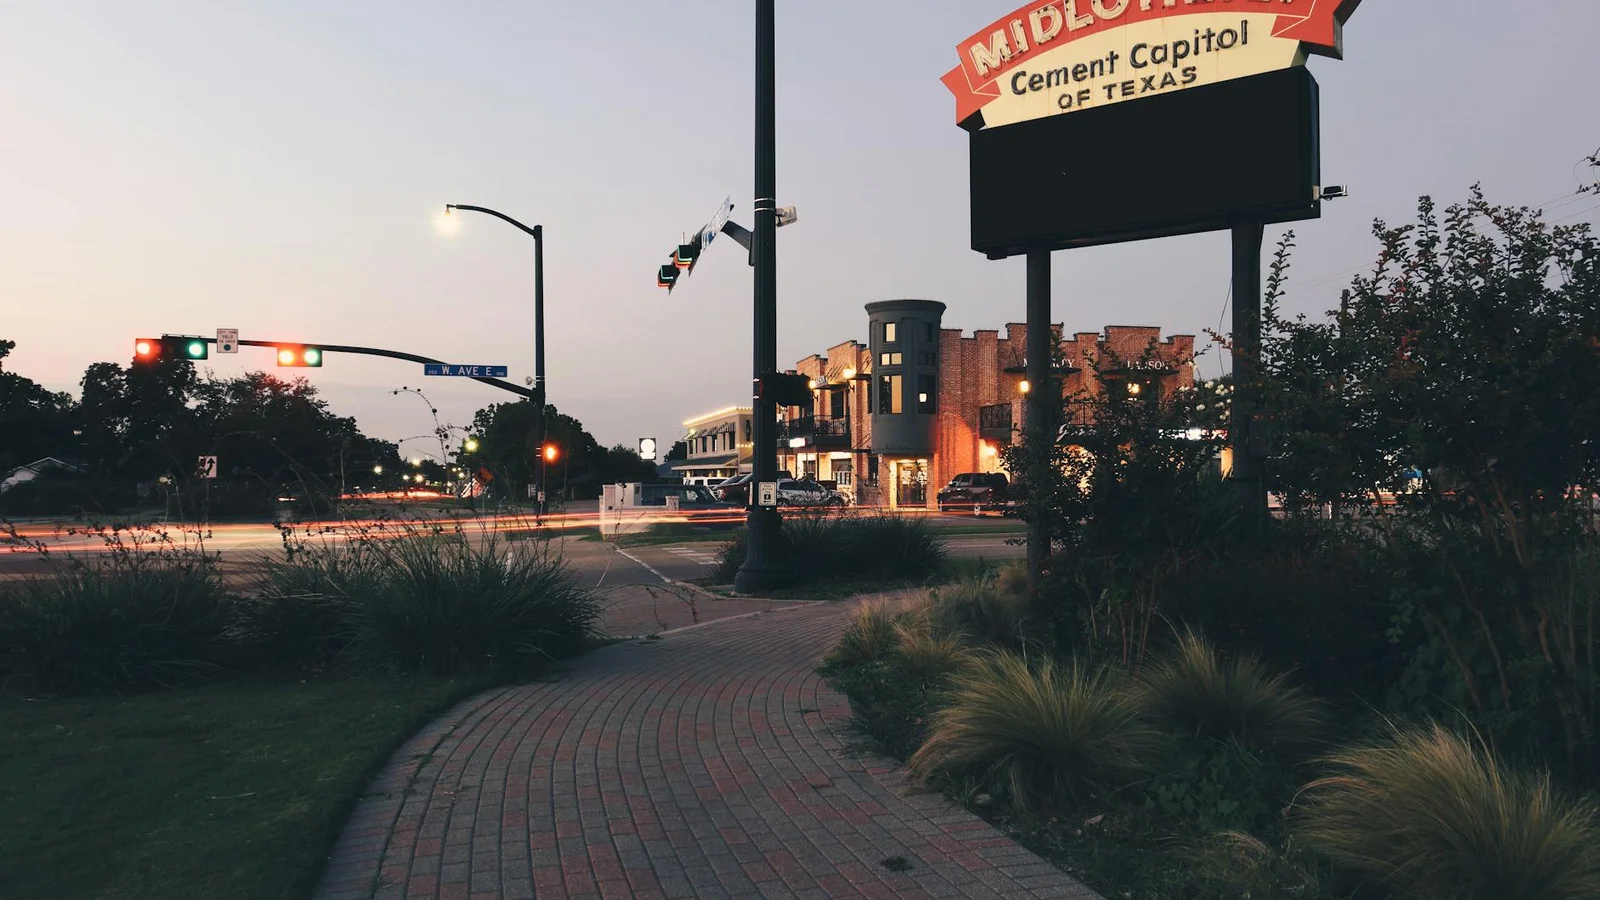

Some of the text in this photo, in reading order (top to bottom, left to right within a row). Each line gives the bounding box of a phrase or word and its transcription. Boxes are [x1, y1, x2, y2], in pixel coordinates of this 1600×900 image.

[1011, 19, 1248, 96] Cement Capitol
[1057, 66, 1198, 110] OF TEXAS
[441, 365, 453, 375] W.
[458, 366, 479, 376] AVE
[485, 366, 492, 376] E
